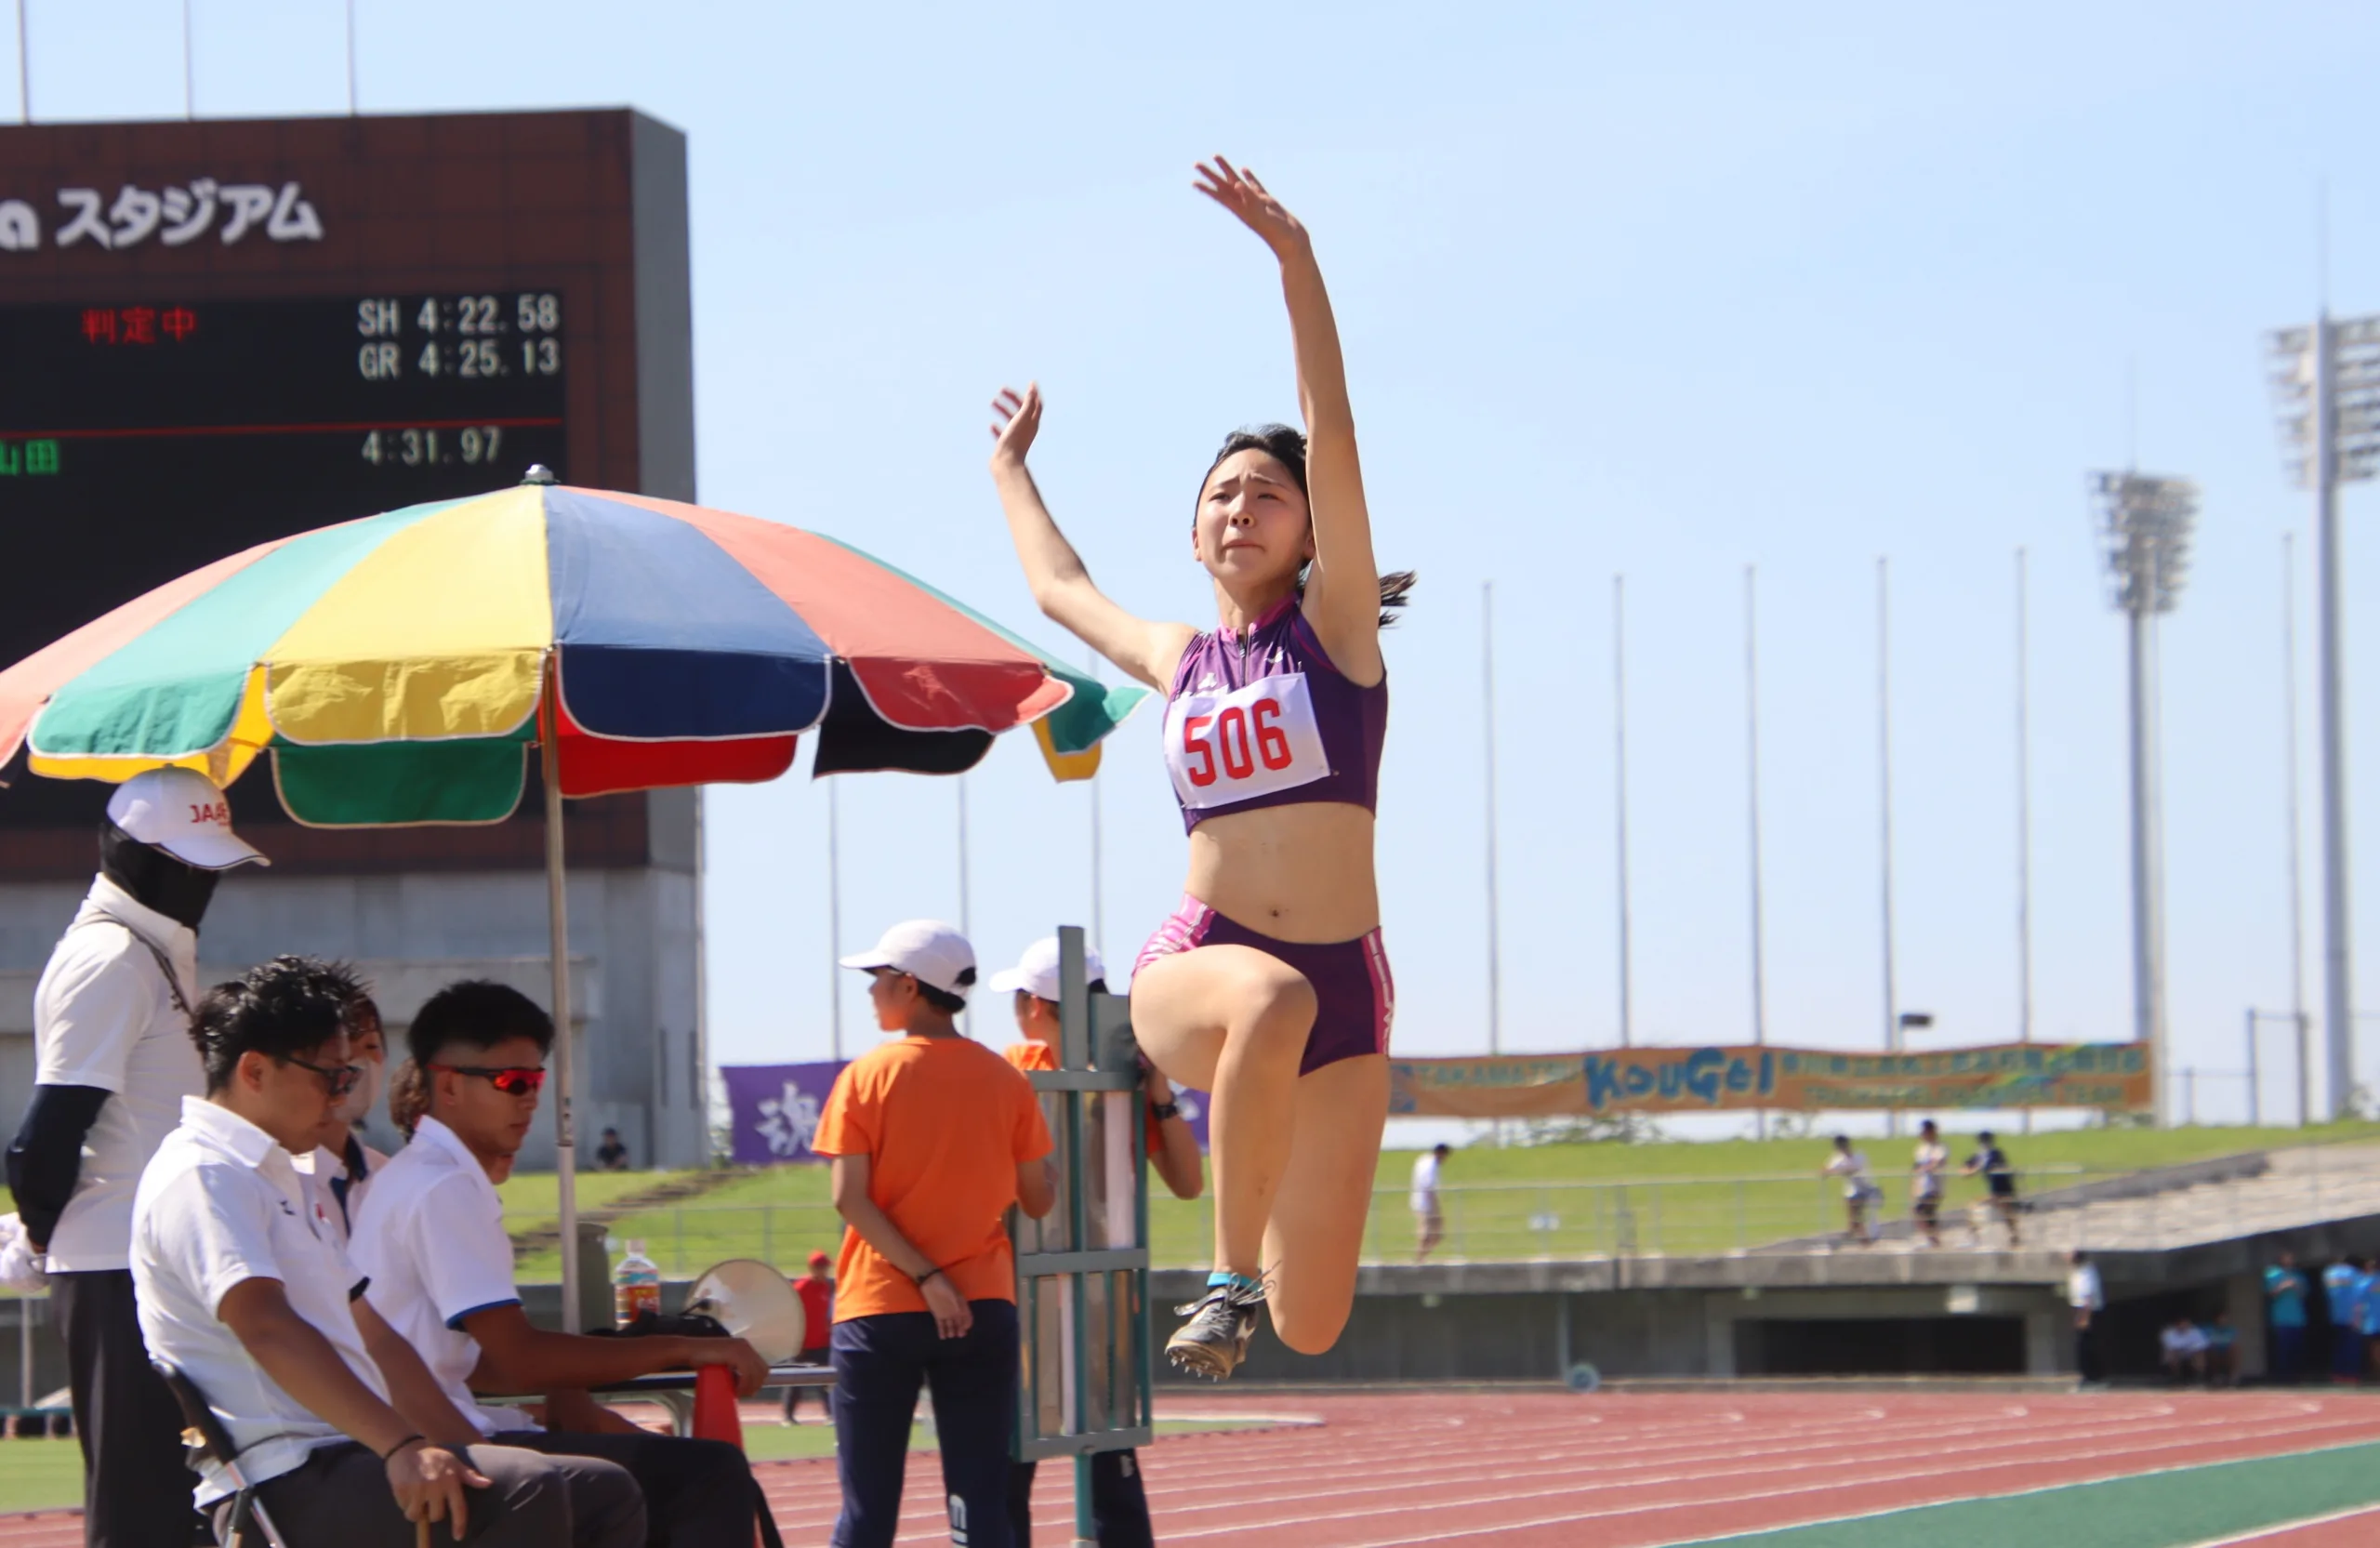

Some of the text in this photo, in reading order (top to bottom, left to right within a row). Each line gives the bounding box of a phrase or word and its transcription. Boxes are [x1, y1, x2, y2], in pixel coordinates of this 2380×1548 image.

[56, 178, 323, 250] スタジアム
[82, 306, 196, 345] 判定中
[358, 294, 560, 337] SH 4:22.58
[359, 337, 561, 380] GR 4:25.13
[361, 425, 501, 465] 4:31.97
[1183, 698, 1292, 787] 506
